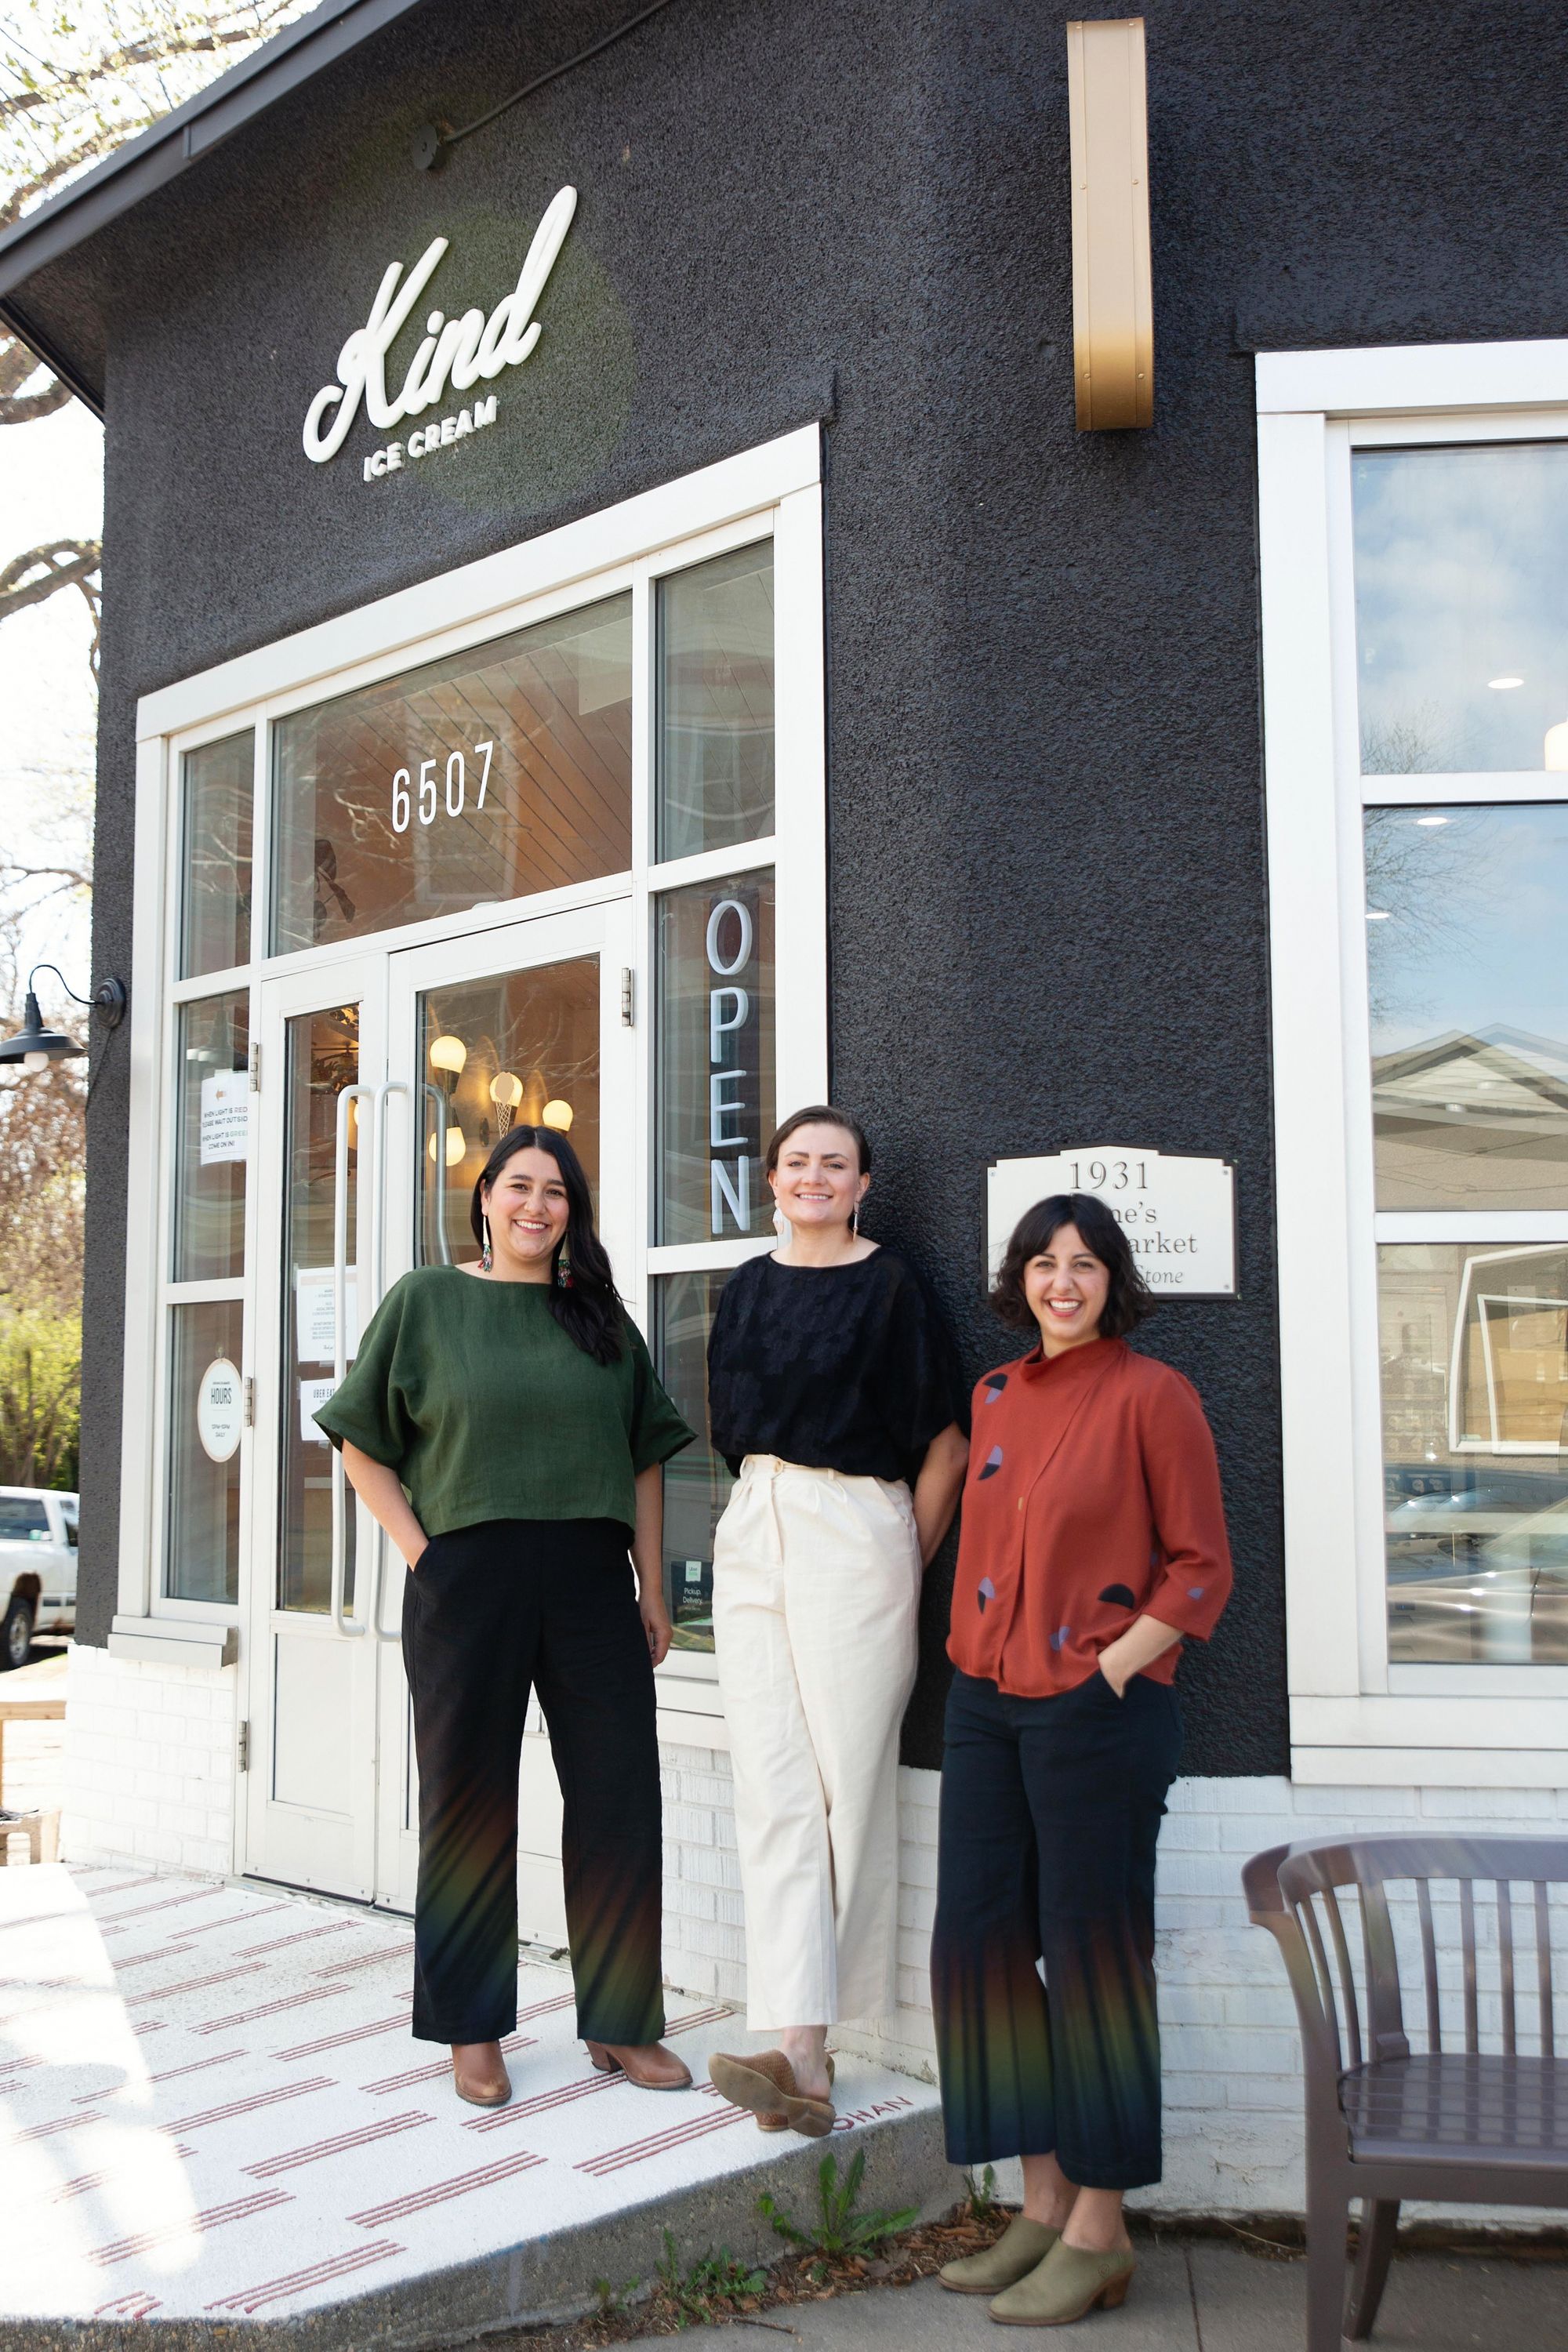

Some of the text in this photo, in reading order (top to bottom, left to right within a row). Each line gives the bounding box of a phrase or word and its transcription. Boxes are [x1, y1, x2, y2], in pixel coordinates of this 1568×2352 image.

[303, 185, 577, 463] Kind
[363, 395, 497, 482] ICE CREAM
[392, 741, 493, 833] 6507
[706, 900, 753, 1234] OPEN
[1069, 1161, 1148, 1189] 1931
[1112, 1201, 1156, 1223] ne's
[1128, 1231, 1197, 1254] arket
[211, 1387, 232, 1405] HOURS
[314, 1388, 325, 1399] UBER
